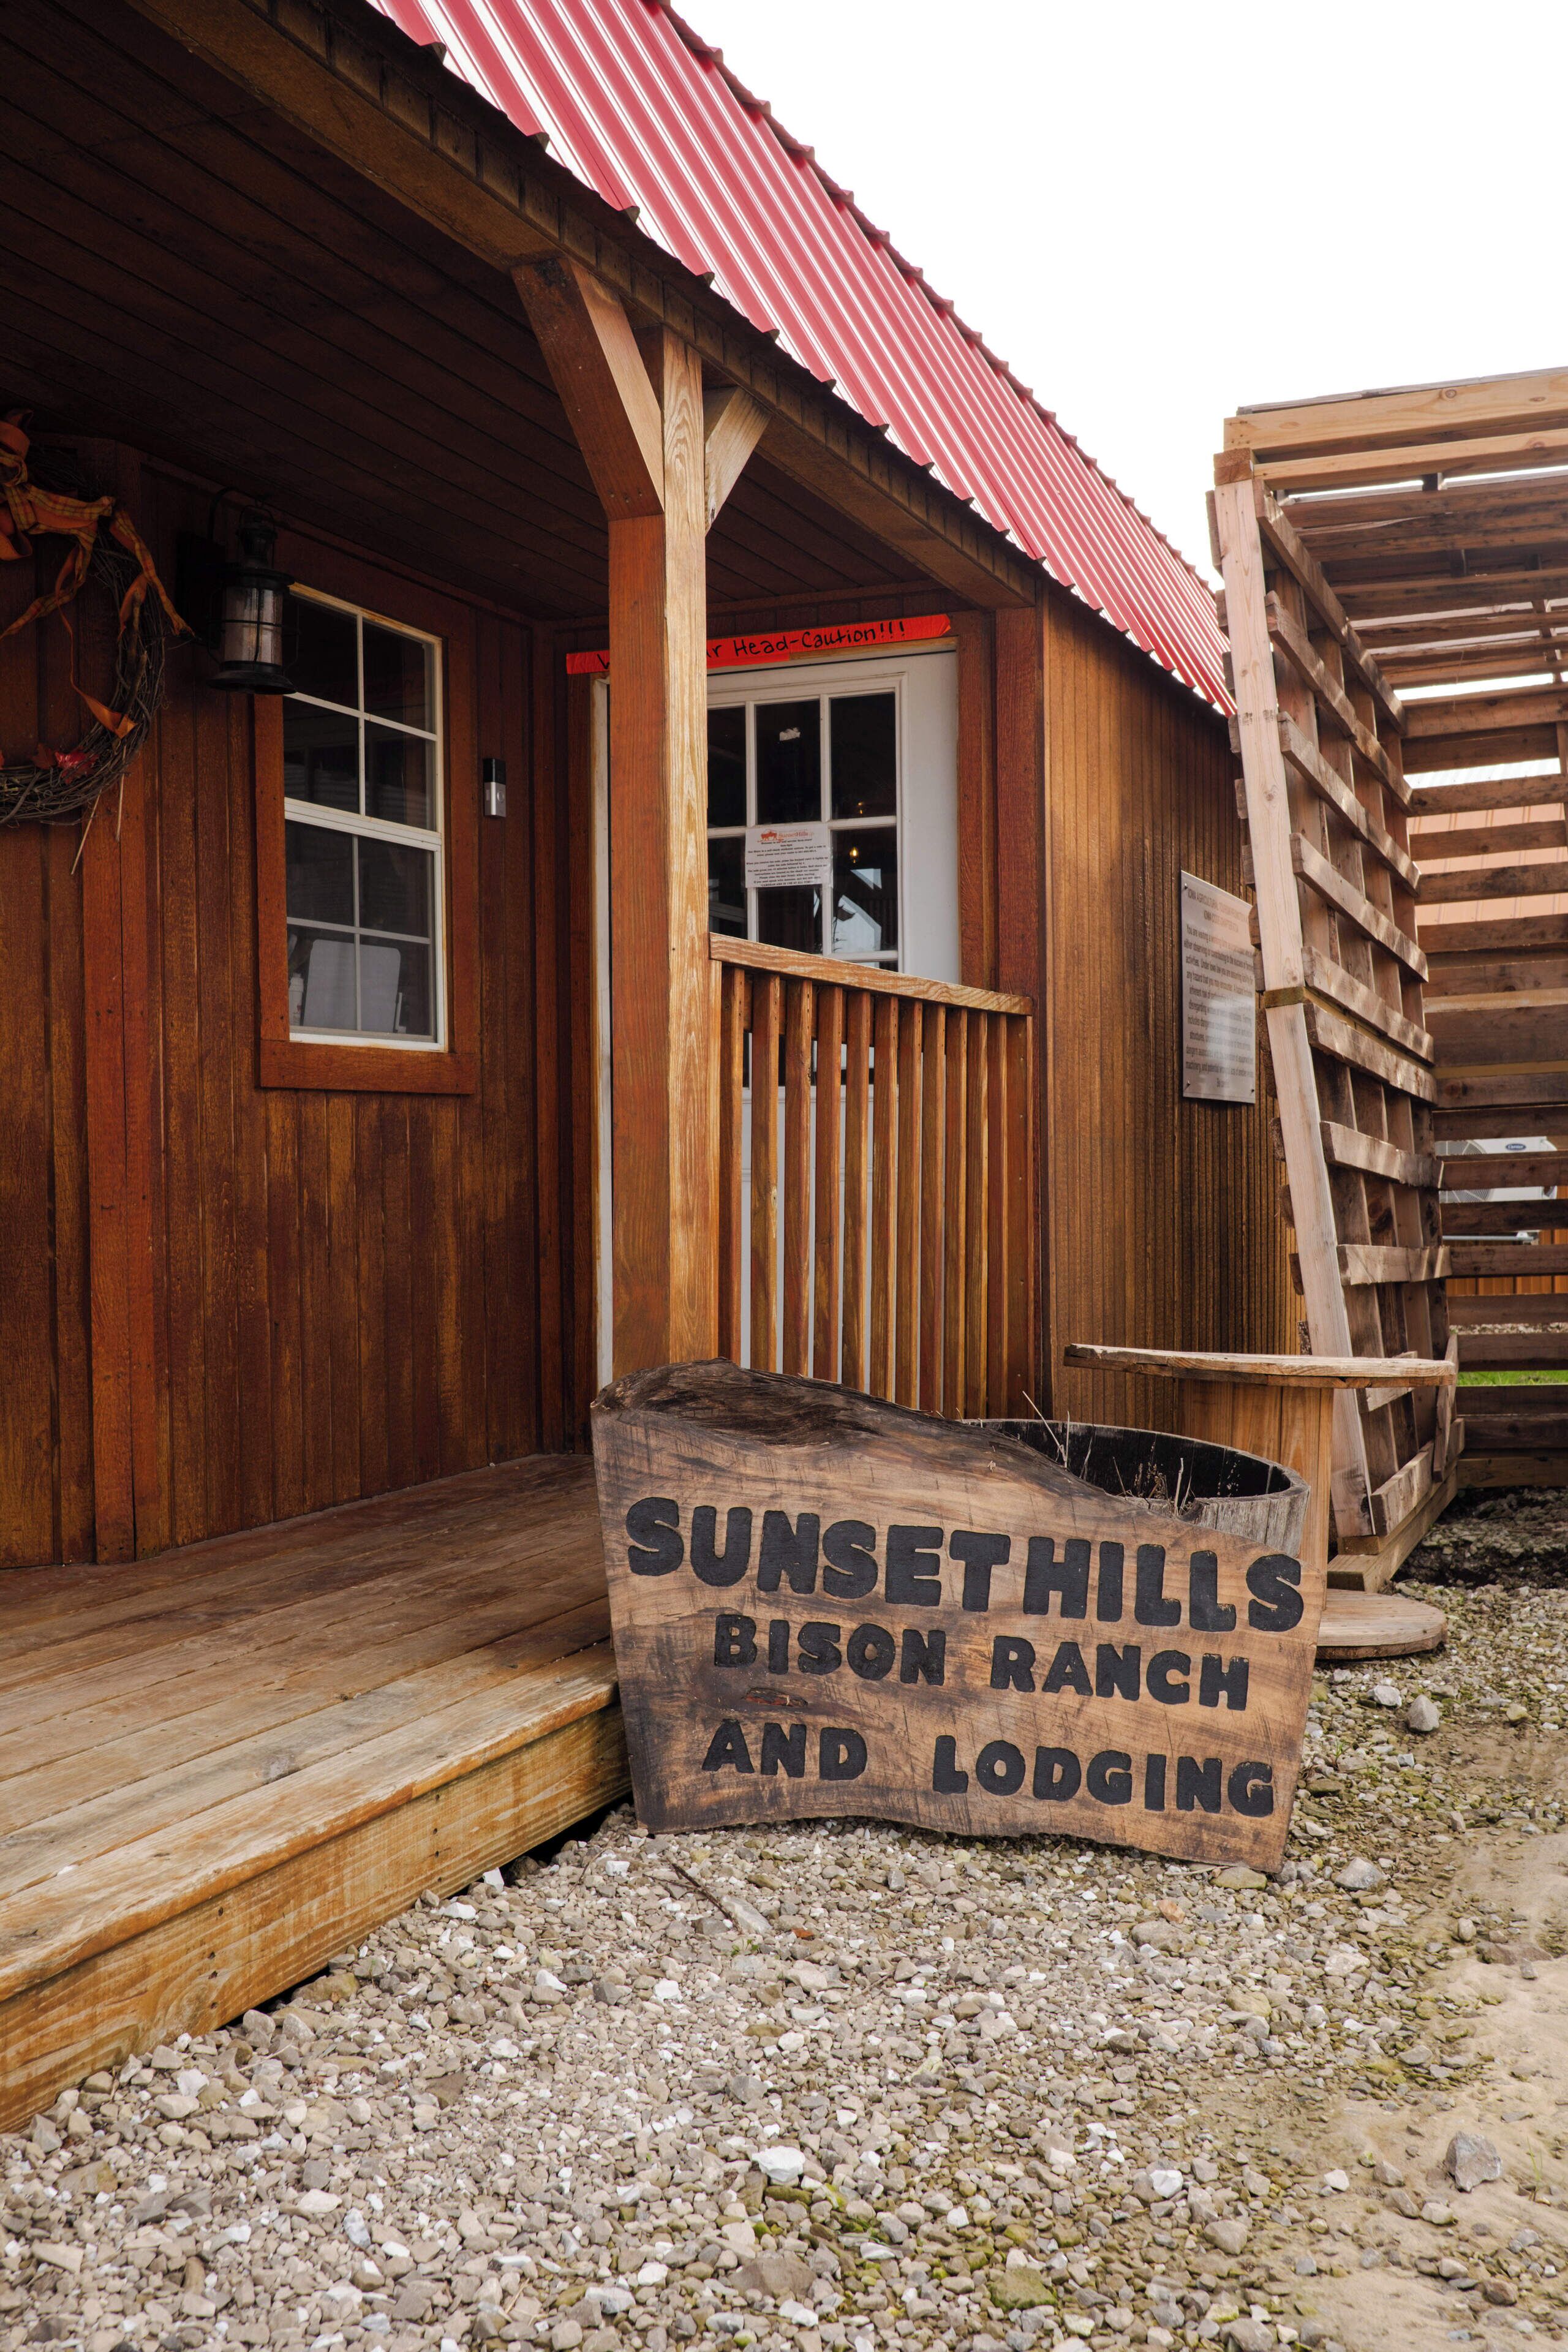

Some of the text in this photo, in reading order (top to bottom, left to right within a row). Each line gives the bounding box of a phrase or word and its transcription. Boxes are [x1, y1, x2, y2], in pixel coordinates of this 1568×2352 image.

[625, 1496, 1305, 1633] SUNSETHILLS
[713, 1613, 1251, 1711] BISON RANCH
[701, 1718, 1275, 1817] AND LODGING
